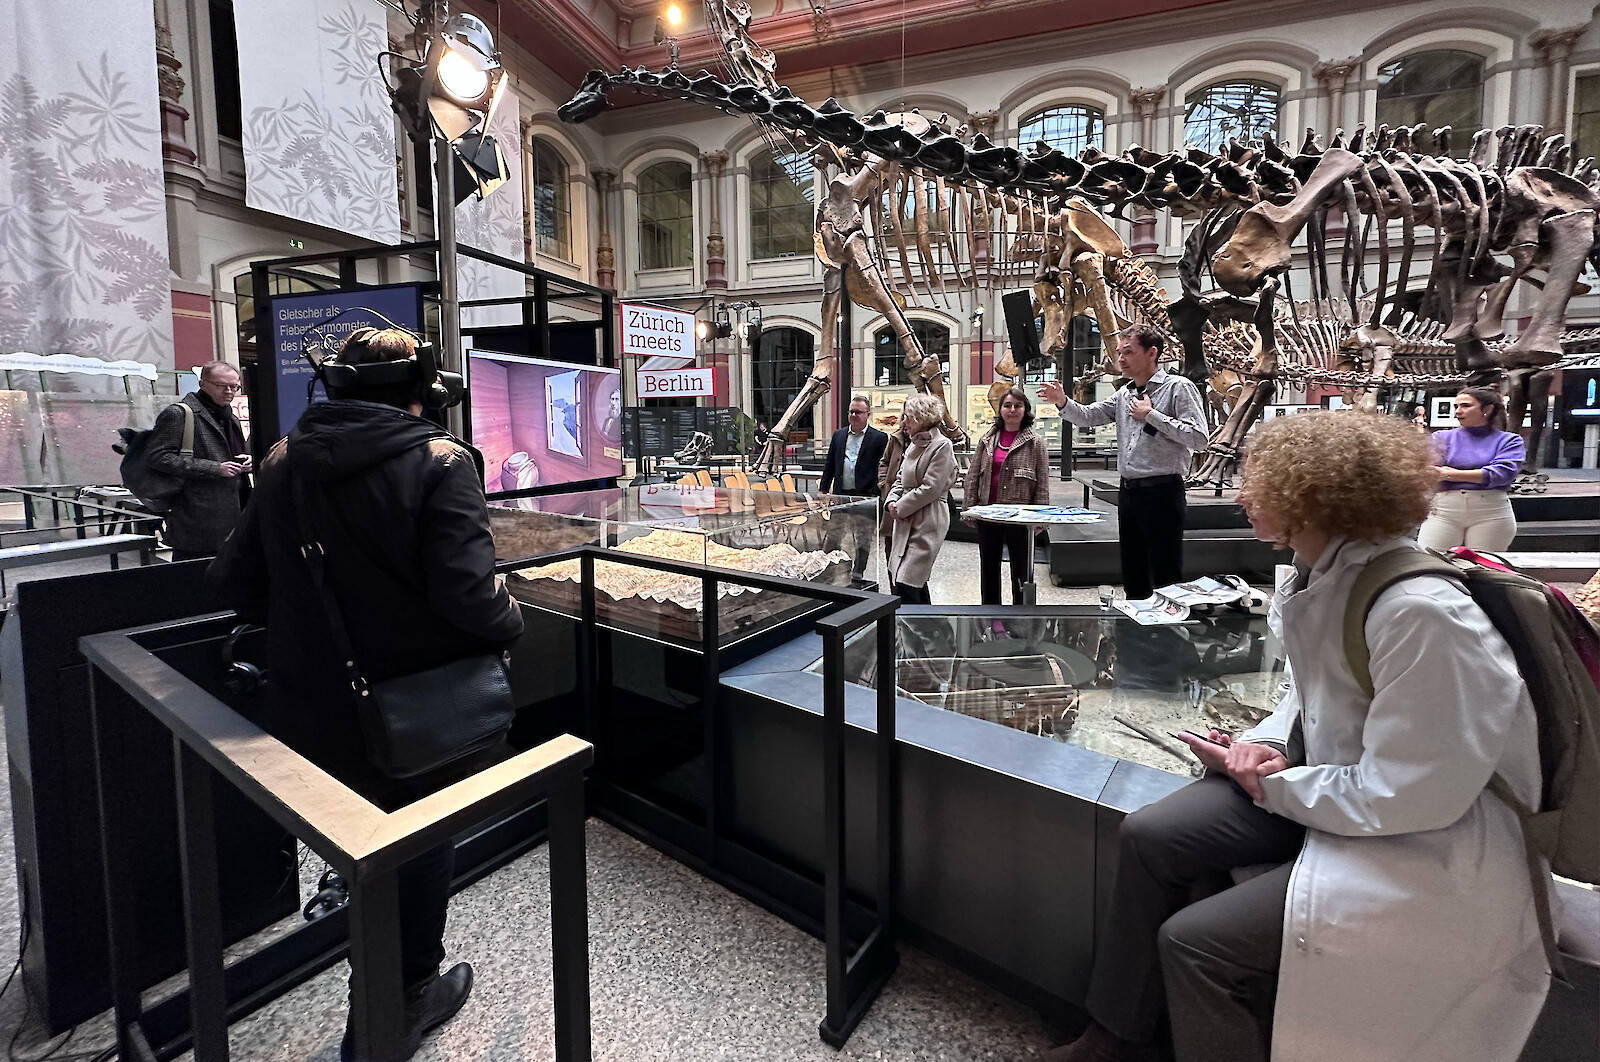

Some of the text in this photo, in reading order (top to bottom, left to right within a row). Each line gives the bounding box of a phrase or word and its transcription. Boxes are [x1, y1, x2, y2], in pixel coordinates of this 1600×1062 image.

[279, 305, 341, 320] Gletscher als
[629, 310, 685, 334] Zürich
[280, 340, 298, 352] des
[629, 333, 682, 352] meets
[644, 374, 704, 393] Berlin
